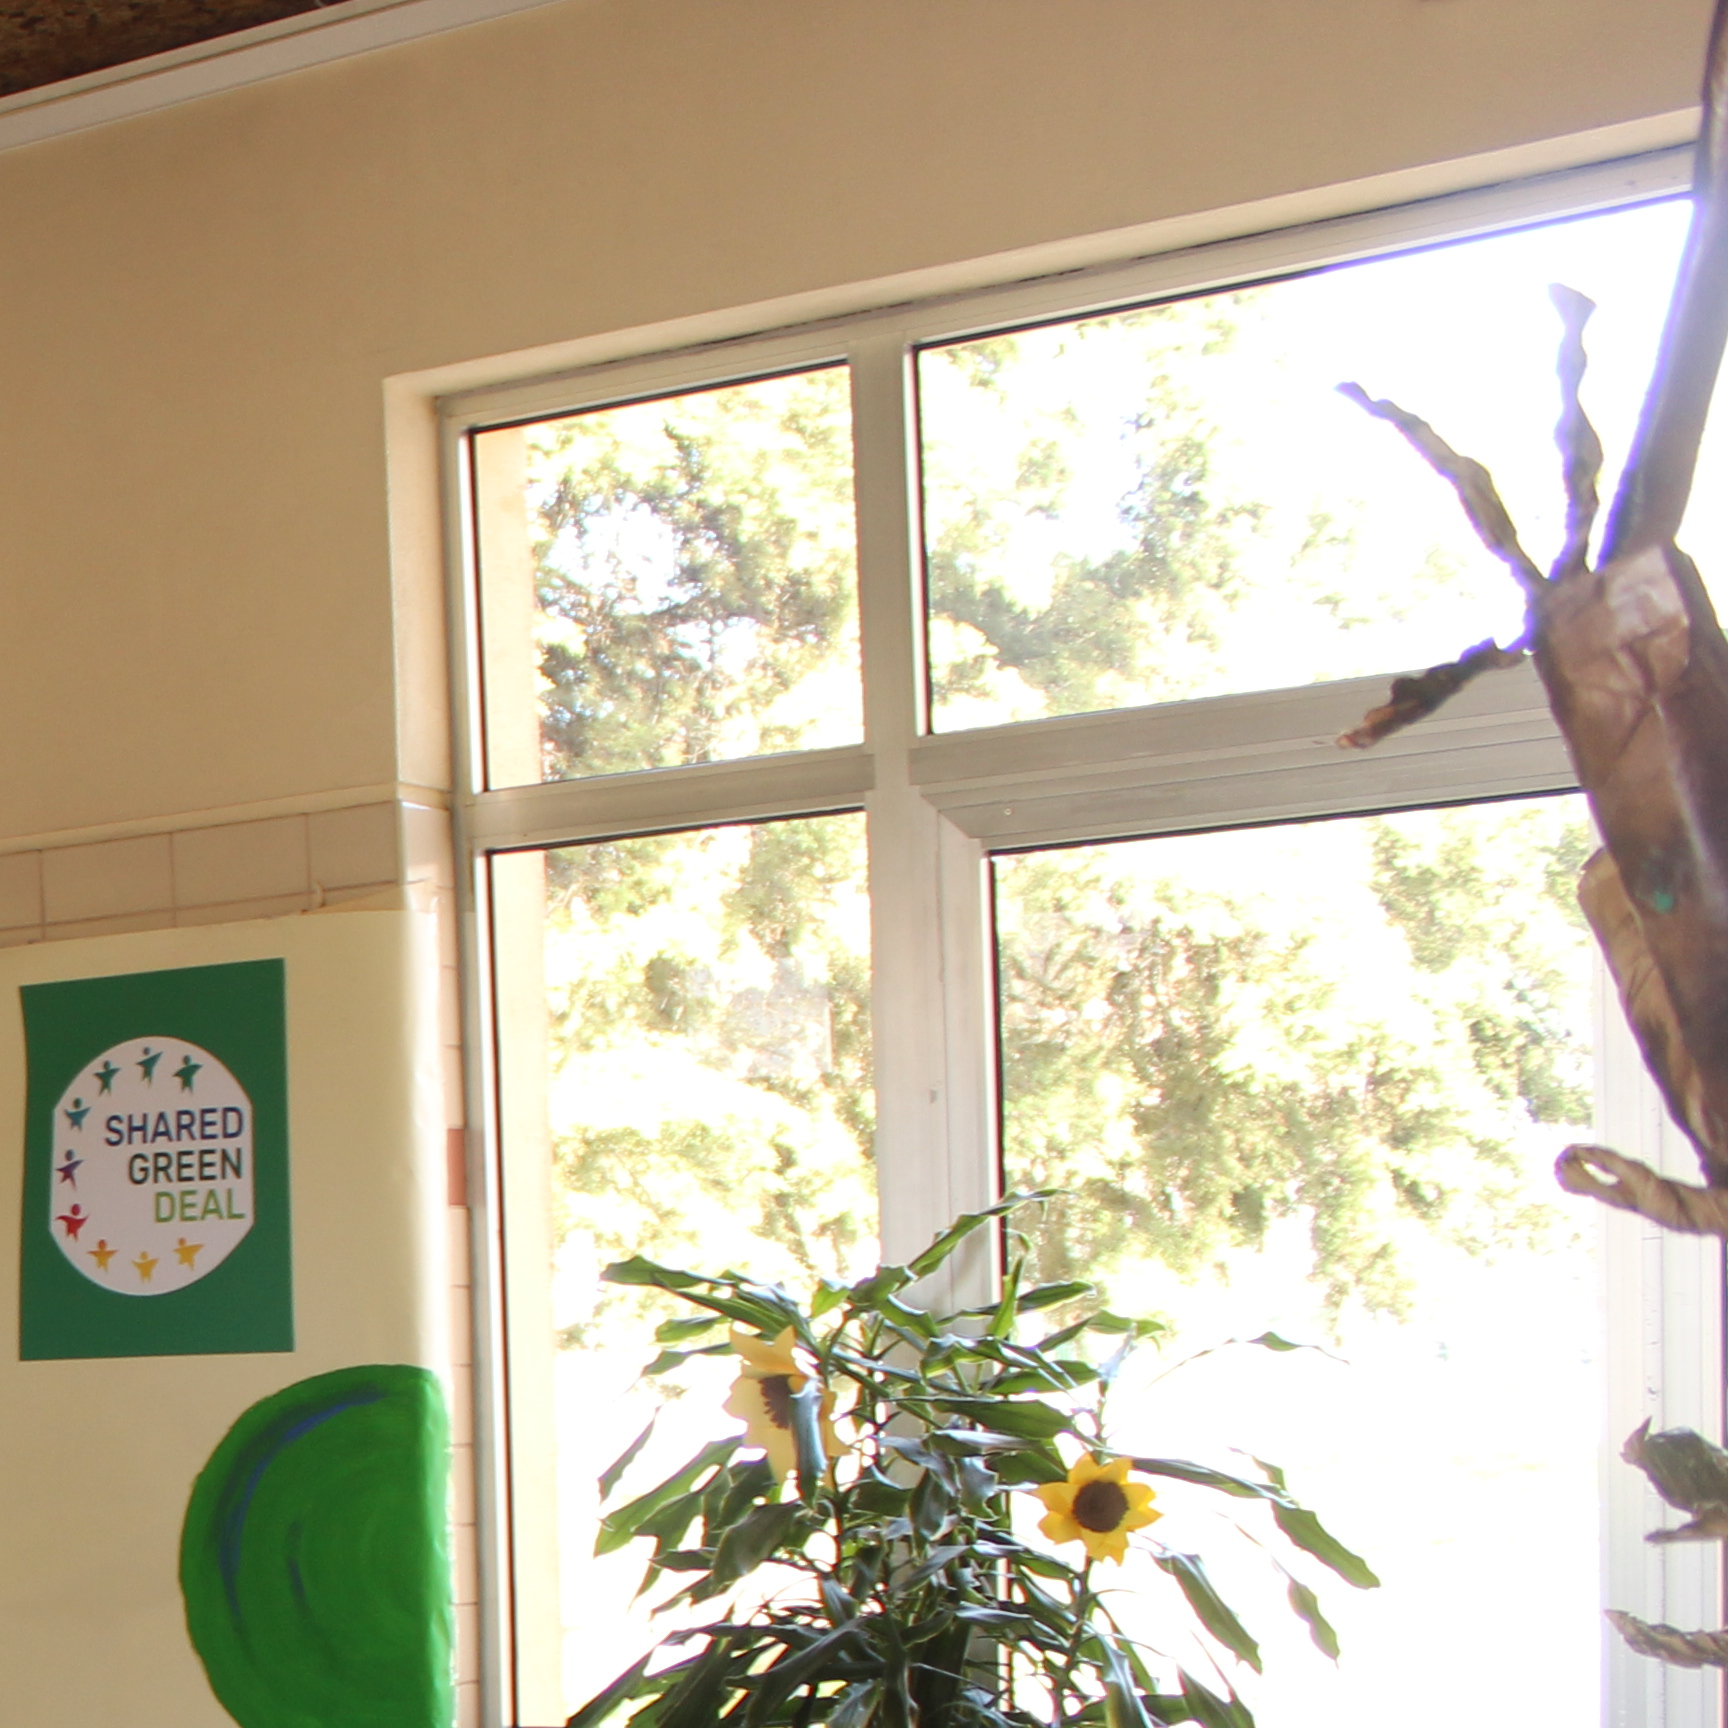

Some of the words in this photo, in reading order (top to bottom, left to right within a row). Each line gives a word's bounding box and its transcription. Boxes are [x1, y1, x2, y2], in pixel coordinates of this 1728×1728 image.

[105, 1106, 243, 1146] SHARED
[128, 1147, 242, 1184] GREEN
[154, 1188, 246, 1223] DEAL
